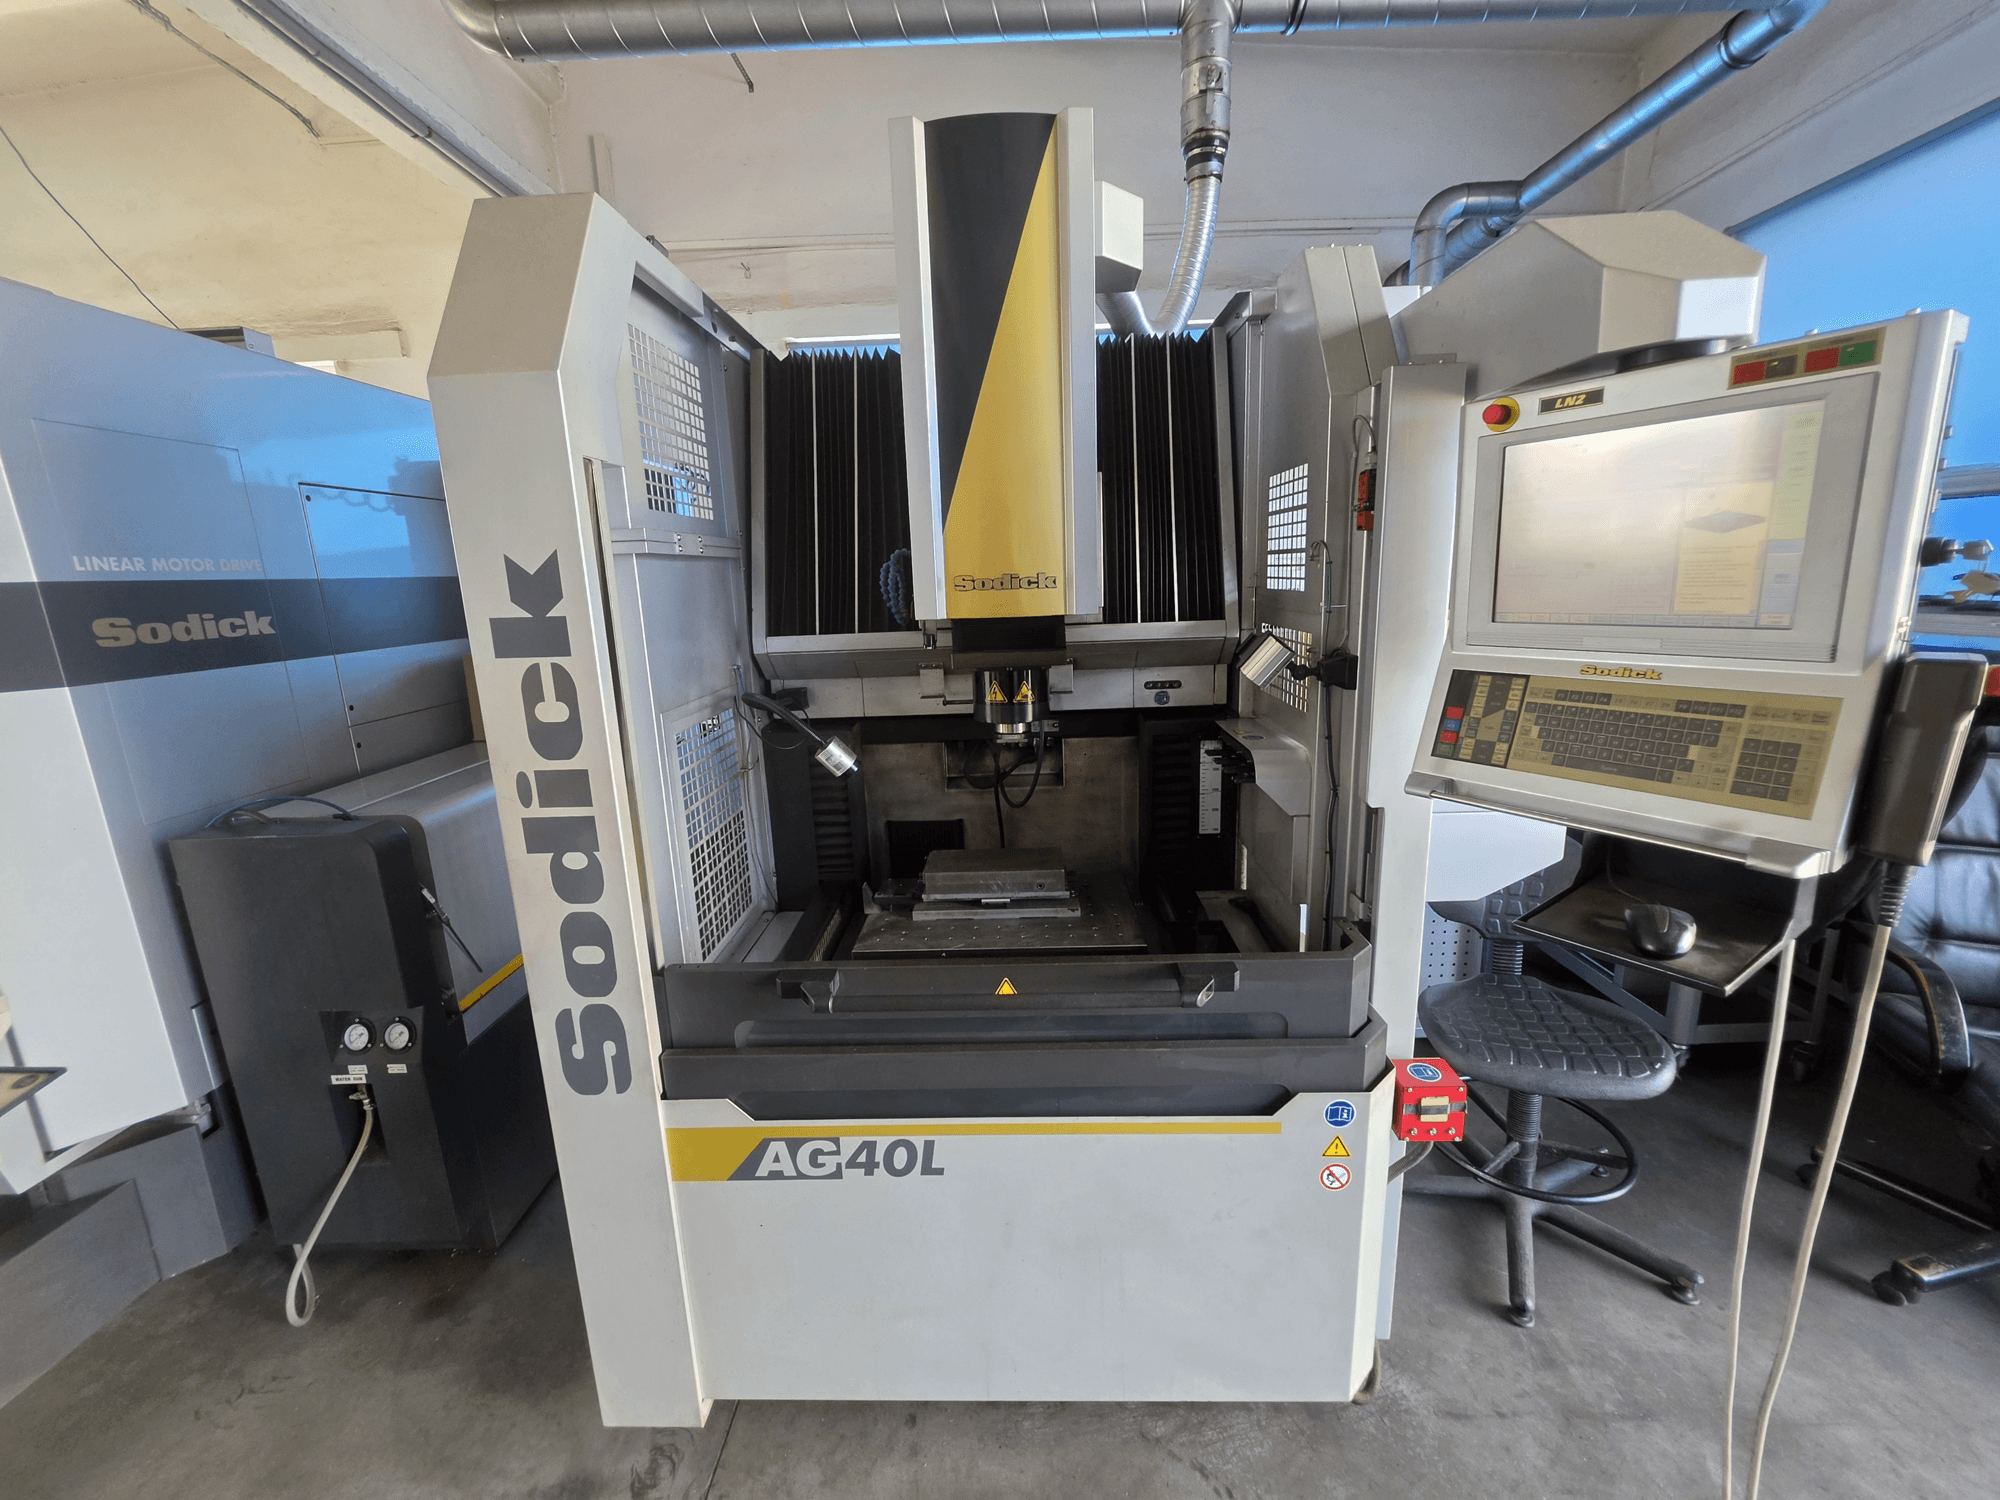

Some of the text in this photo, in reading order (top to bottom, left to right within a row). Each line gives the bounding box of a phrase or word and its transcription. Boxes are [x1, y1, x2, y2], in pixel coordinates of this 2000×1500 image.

[72, 556, 262, 572] LINEAR MOTOR DRIVE
[953, 572, 1057, 592] Sodick
[92, 611, 276, 648] Sodick
[1580, 664, 1662, 680] Sodick
[489, 548, 632, 1096] Sodick
[755, 1138, 945, 1178] AG40L
